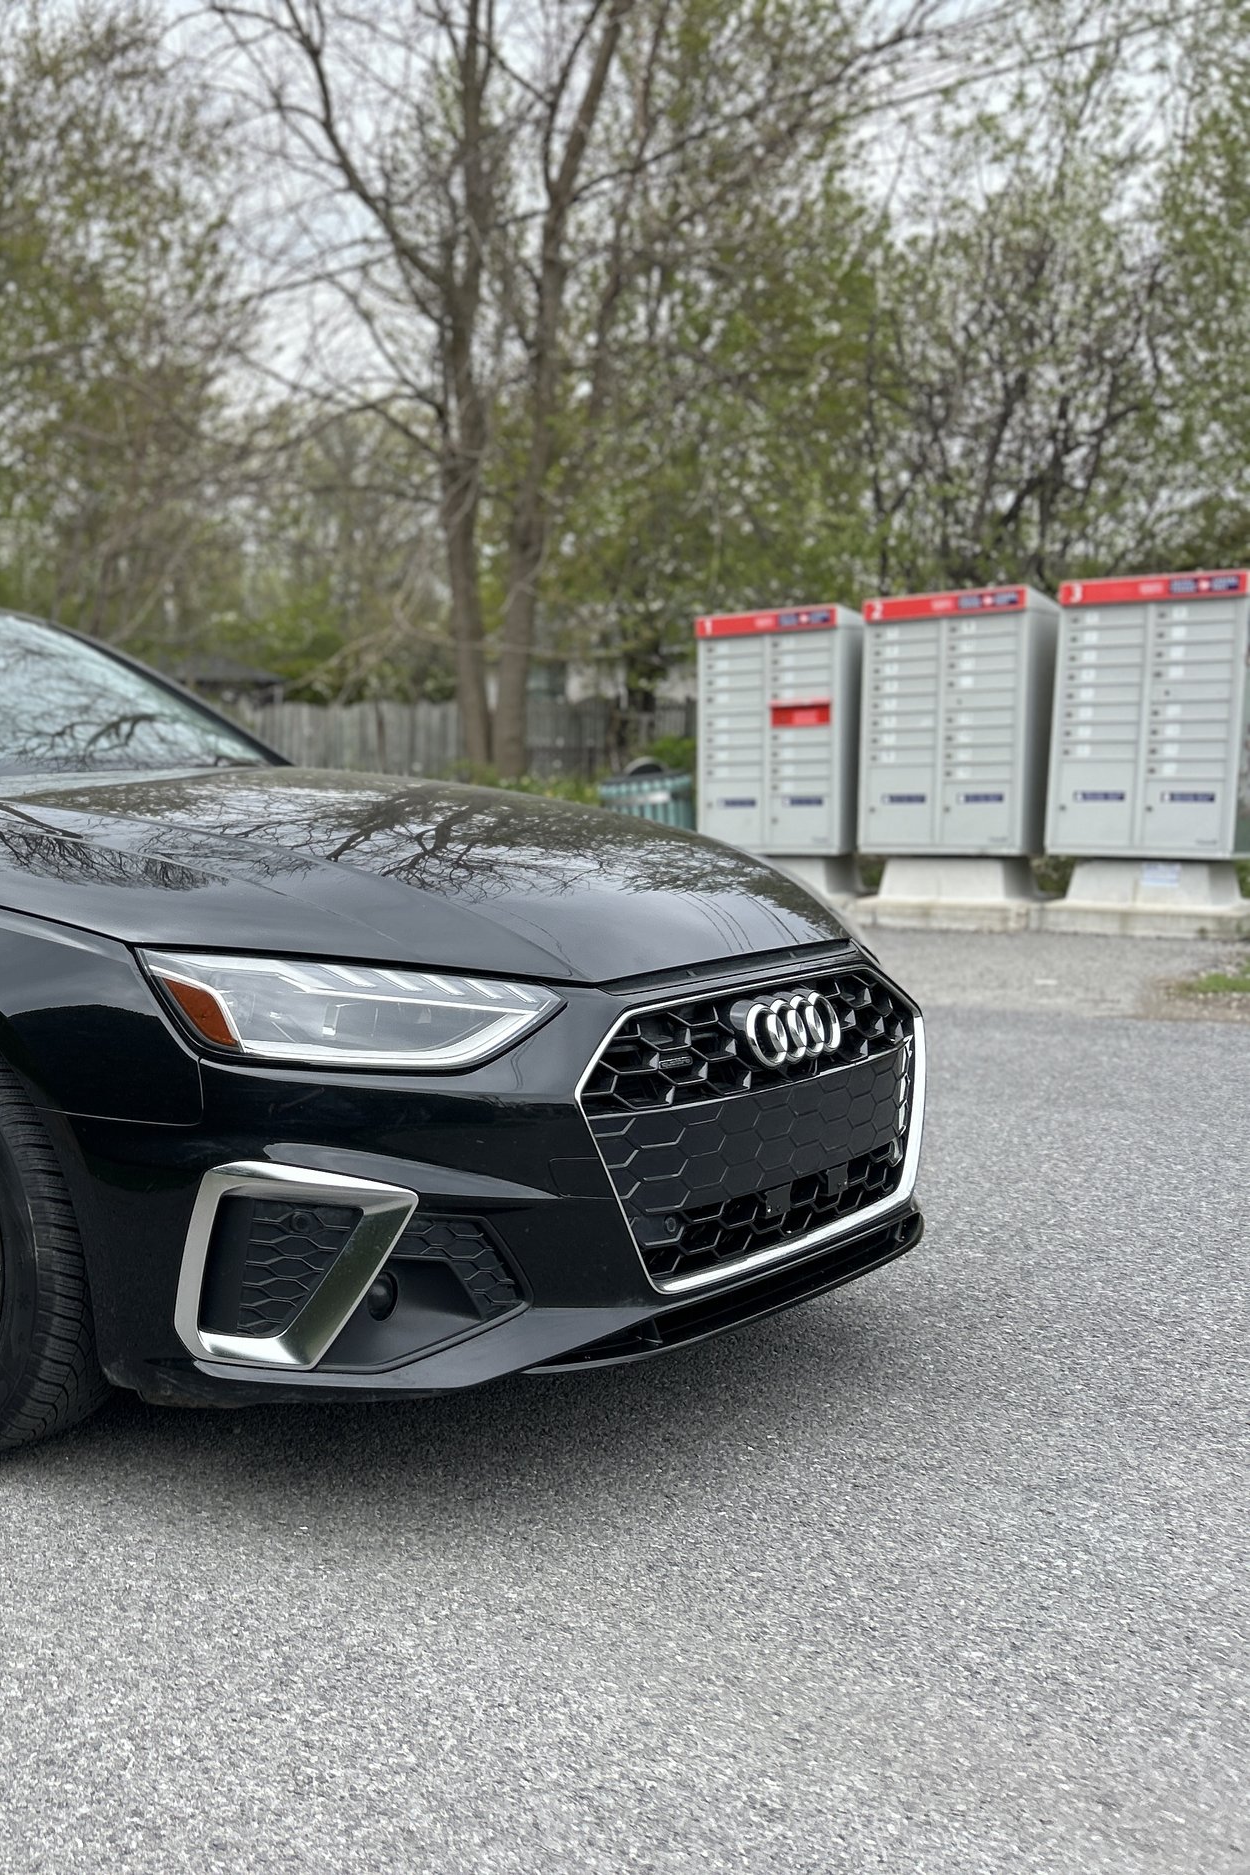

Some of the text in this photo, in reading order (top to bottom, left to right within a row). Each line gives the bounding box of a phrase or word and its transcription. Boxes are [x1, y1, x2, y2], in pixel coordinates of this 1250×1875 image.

[1070, 584, 1083, 603] 3
[870, 602, 884, 620] 2
[704, 619, 713, 636] 1
